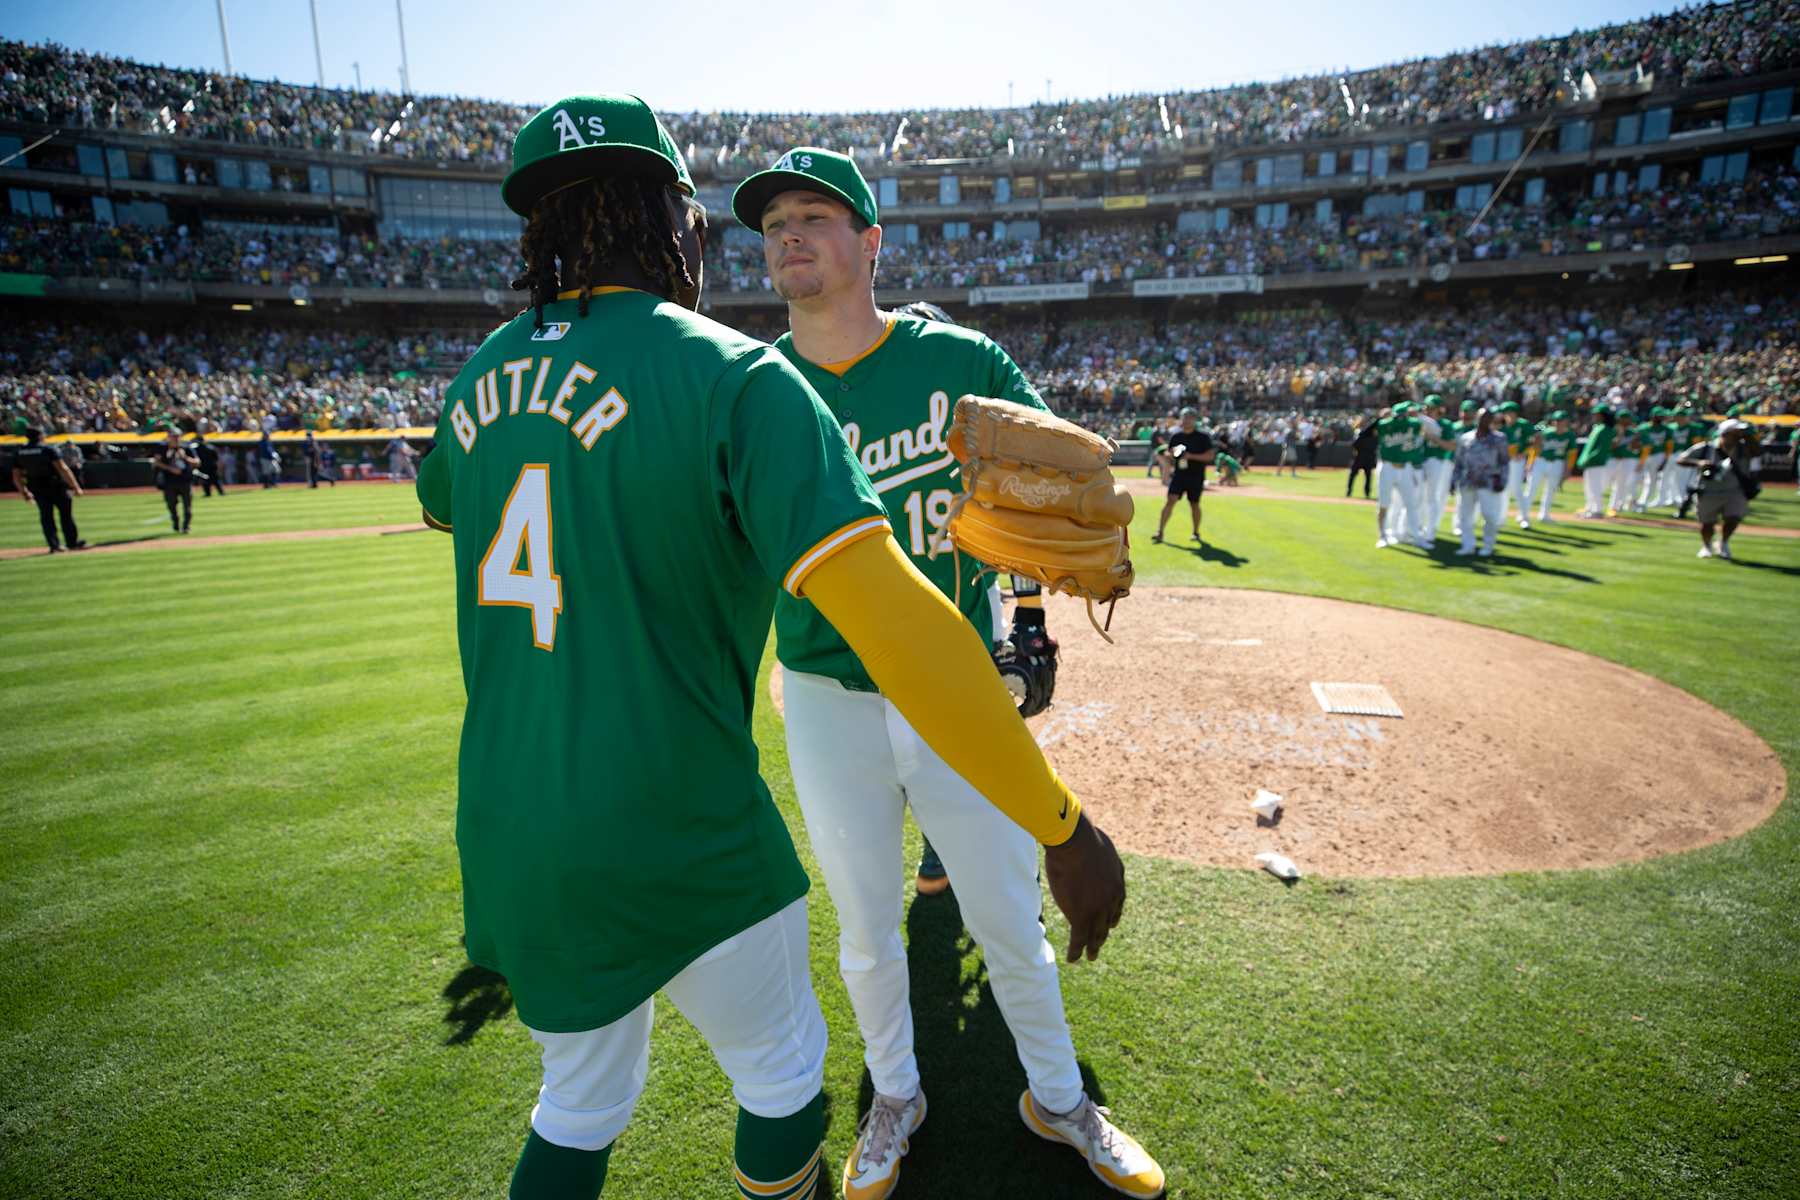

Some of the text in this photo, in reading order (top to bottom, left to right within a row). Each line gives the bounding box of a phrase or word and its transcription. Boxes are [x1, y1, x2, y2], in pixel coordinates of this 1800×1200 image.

[552, 108, 606, 152] A's
[778, 151, 812, 171] A's
[450, 356, 629, 455] BUTLER
[999, 474, 1073, 505] Rawlings
[904, 489, 954, 556] 19
[478, 463, 563, 653] 4
